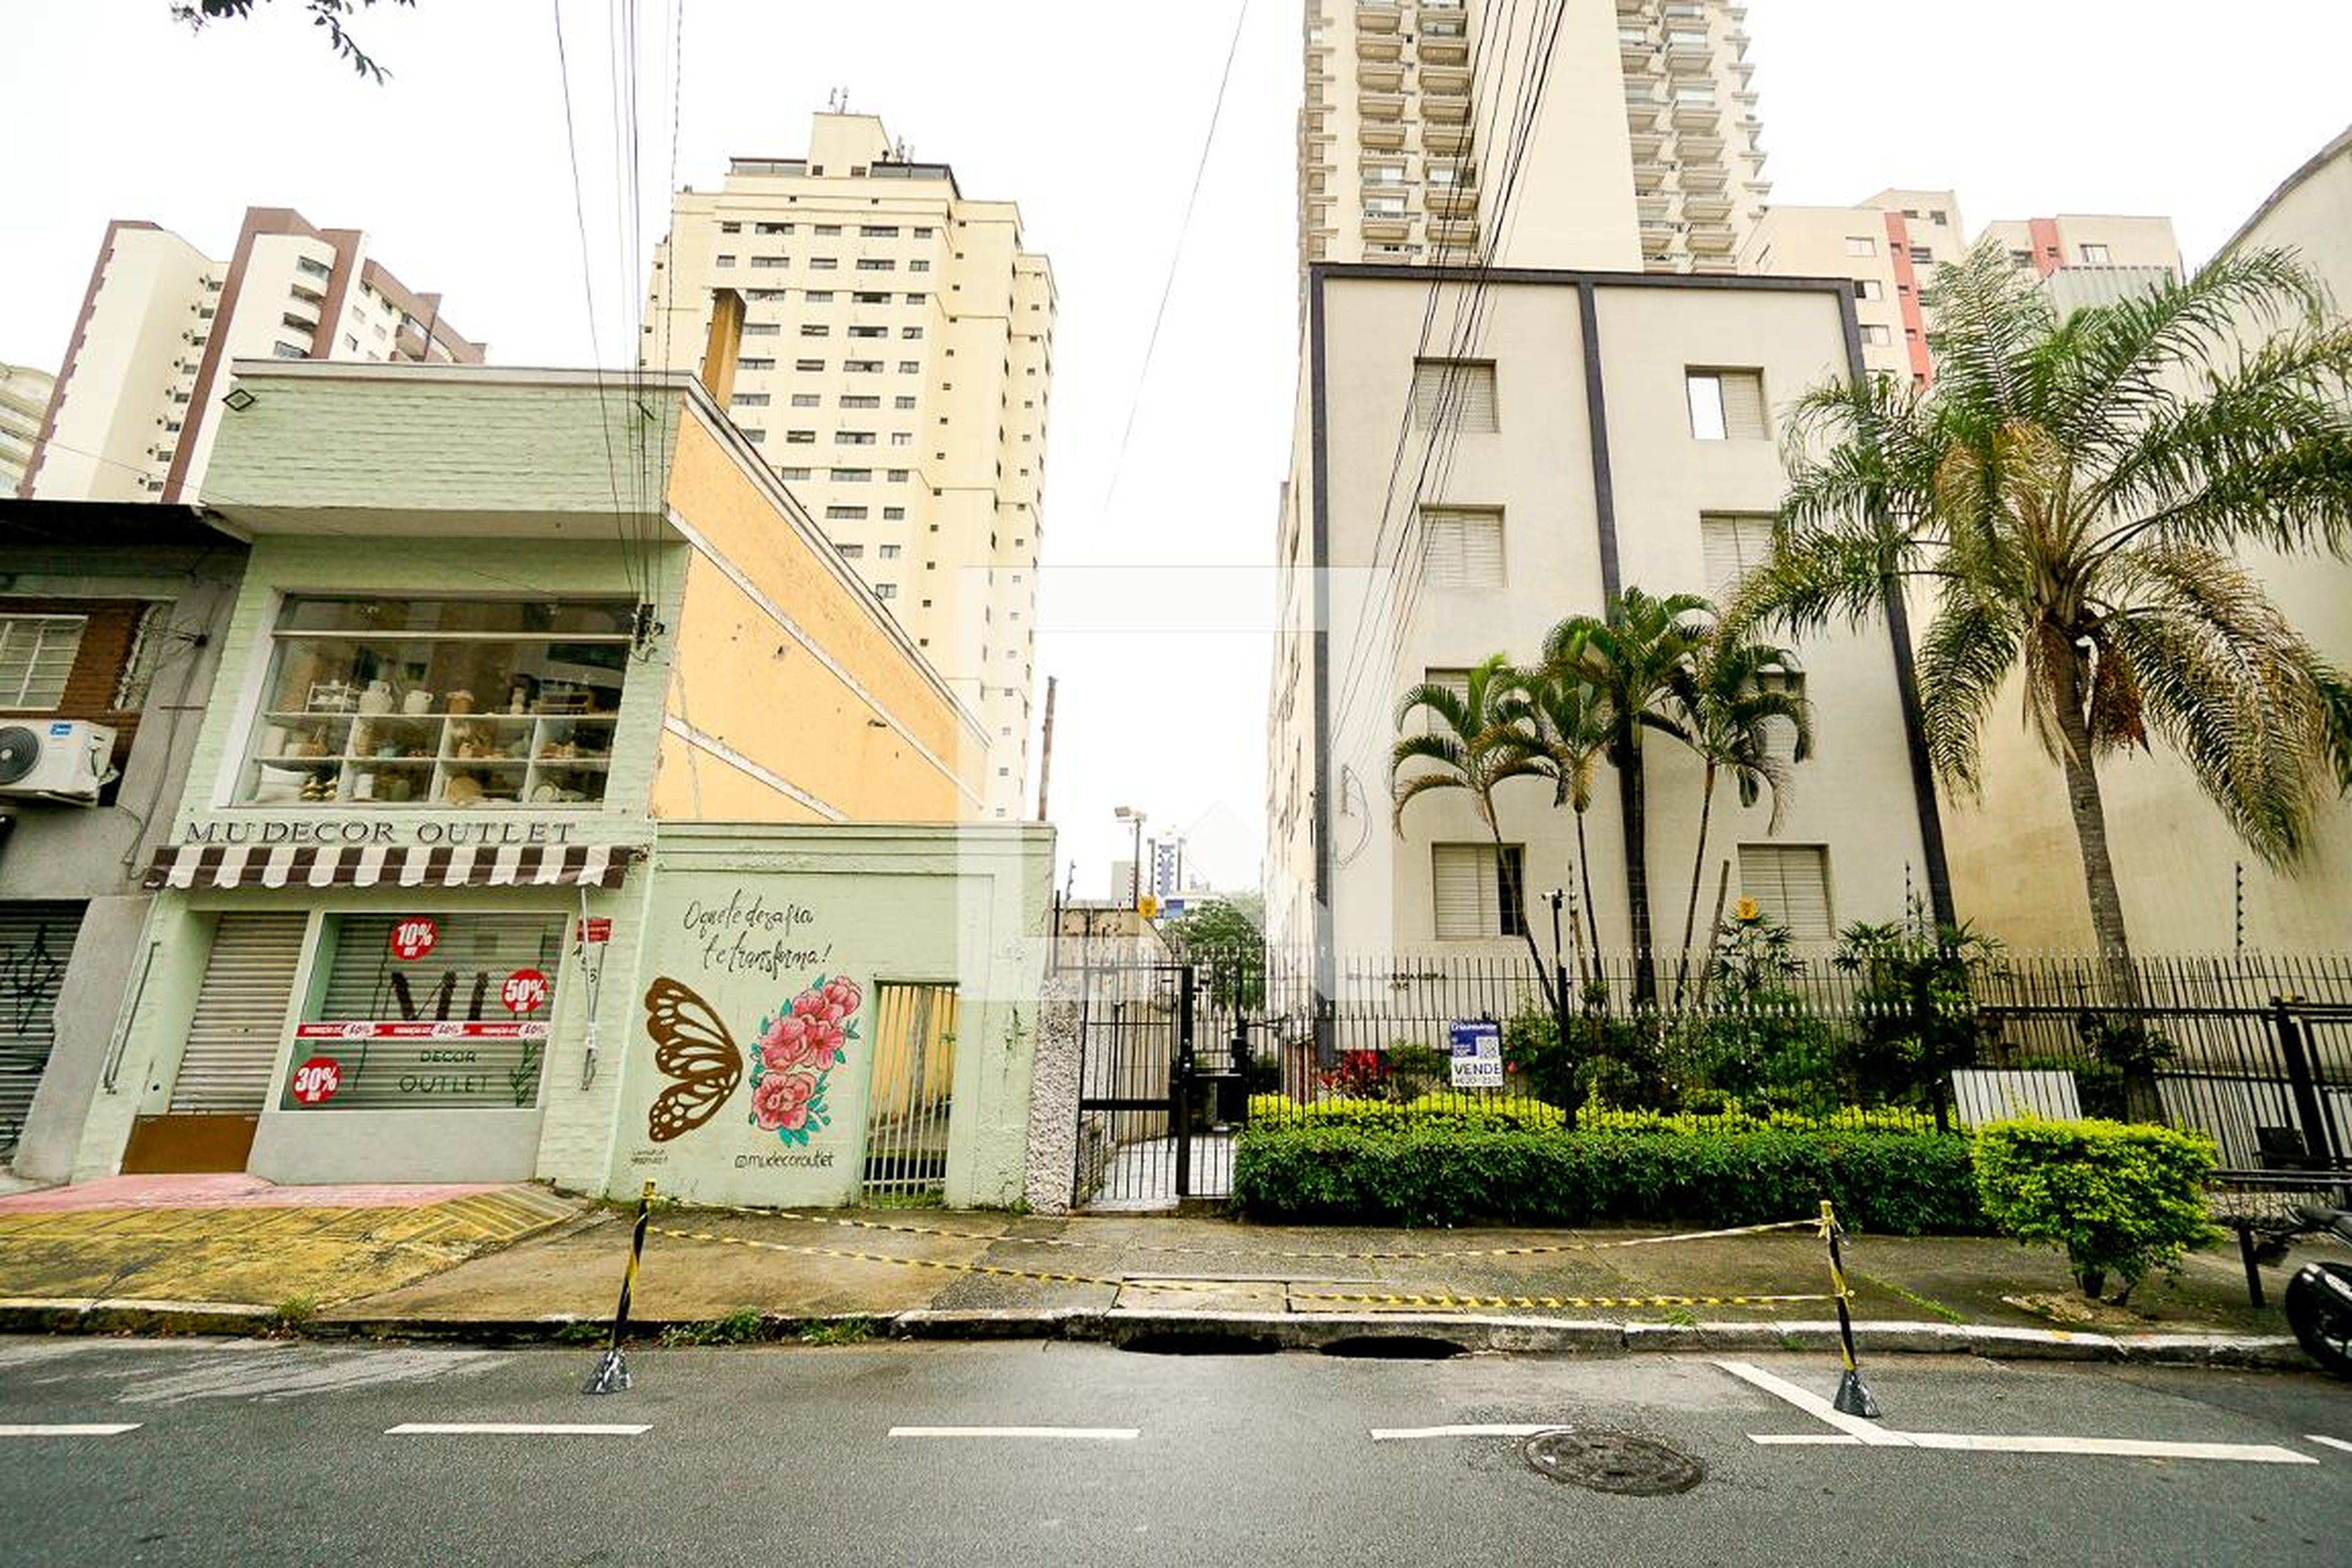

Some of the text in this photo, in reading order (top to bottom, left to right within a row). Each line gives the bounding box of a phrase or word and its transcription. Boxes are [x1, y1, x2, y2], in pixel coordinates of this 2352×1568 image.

[261, 821, 396, 843] DECOR
[417, 823, 576, 844] OUTLET
[398, 923, 434, 946] 10%
[728, 930, 832, 980] transforma!
[504, 979, 544, 1003] 50%
[420, 1050, 477, 1063] DECOR
[295, 1067, 337, 1092] 30%
[1454, 1063, 1501, 1075] VENDE
[399, 1075, 488, 1093] OUTLET
